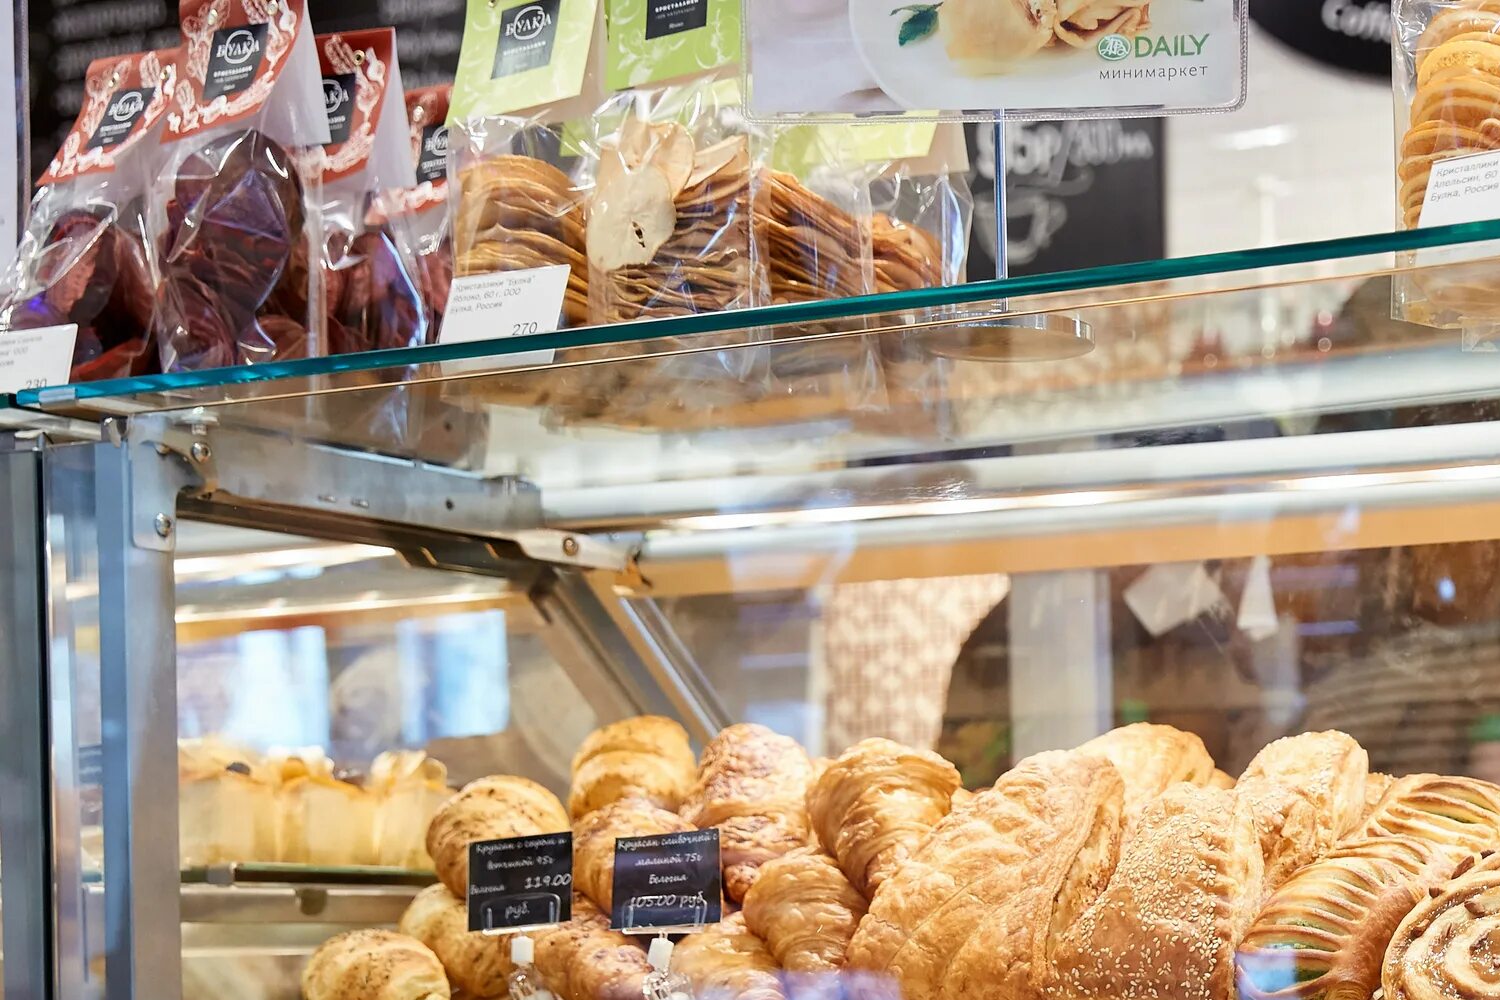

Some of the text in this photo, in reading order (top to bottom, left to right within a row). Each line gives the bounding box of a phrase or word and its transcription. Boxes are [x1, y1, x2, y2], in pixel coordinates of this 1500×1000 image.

[1134, 33, 1210, 58] DAILY
[1099, 65, 1208, 81] минимаркет
[1436, 160, 1499, 177] Кристаллики
[1484, 170, 1497, 180] 60
[1464, 183, 1500, 194] Россия
[512, 321, 538, 336] 270
[524, 873, 572, 890] 119.00
[505, 900, 531, 920] руб.
